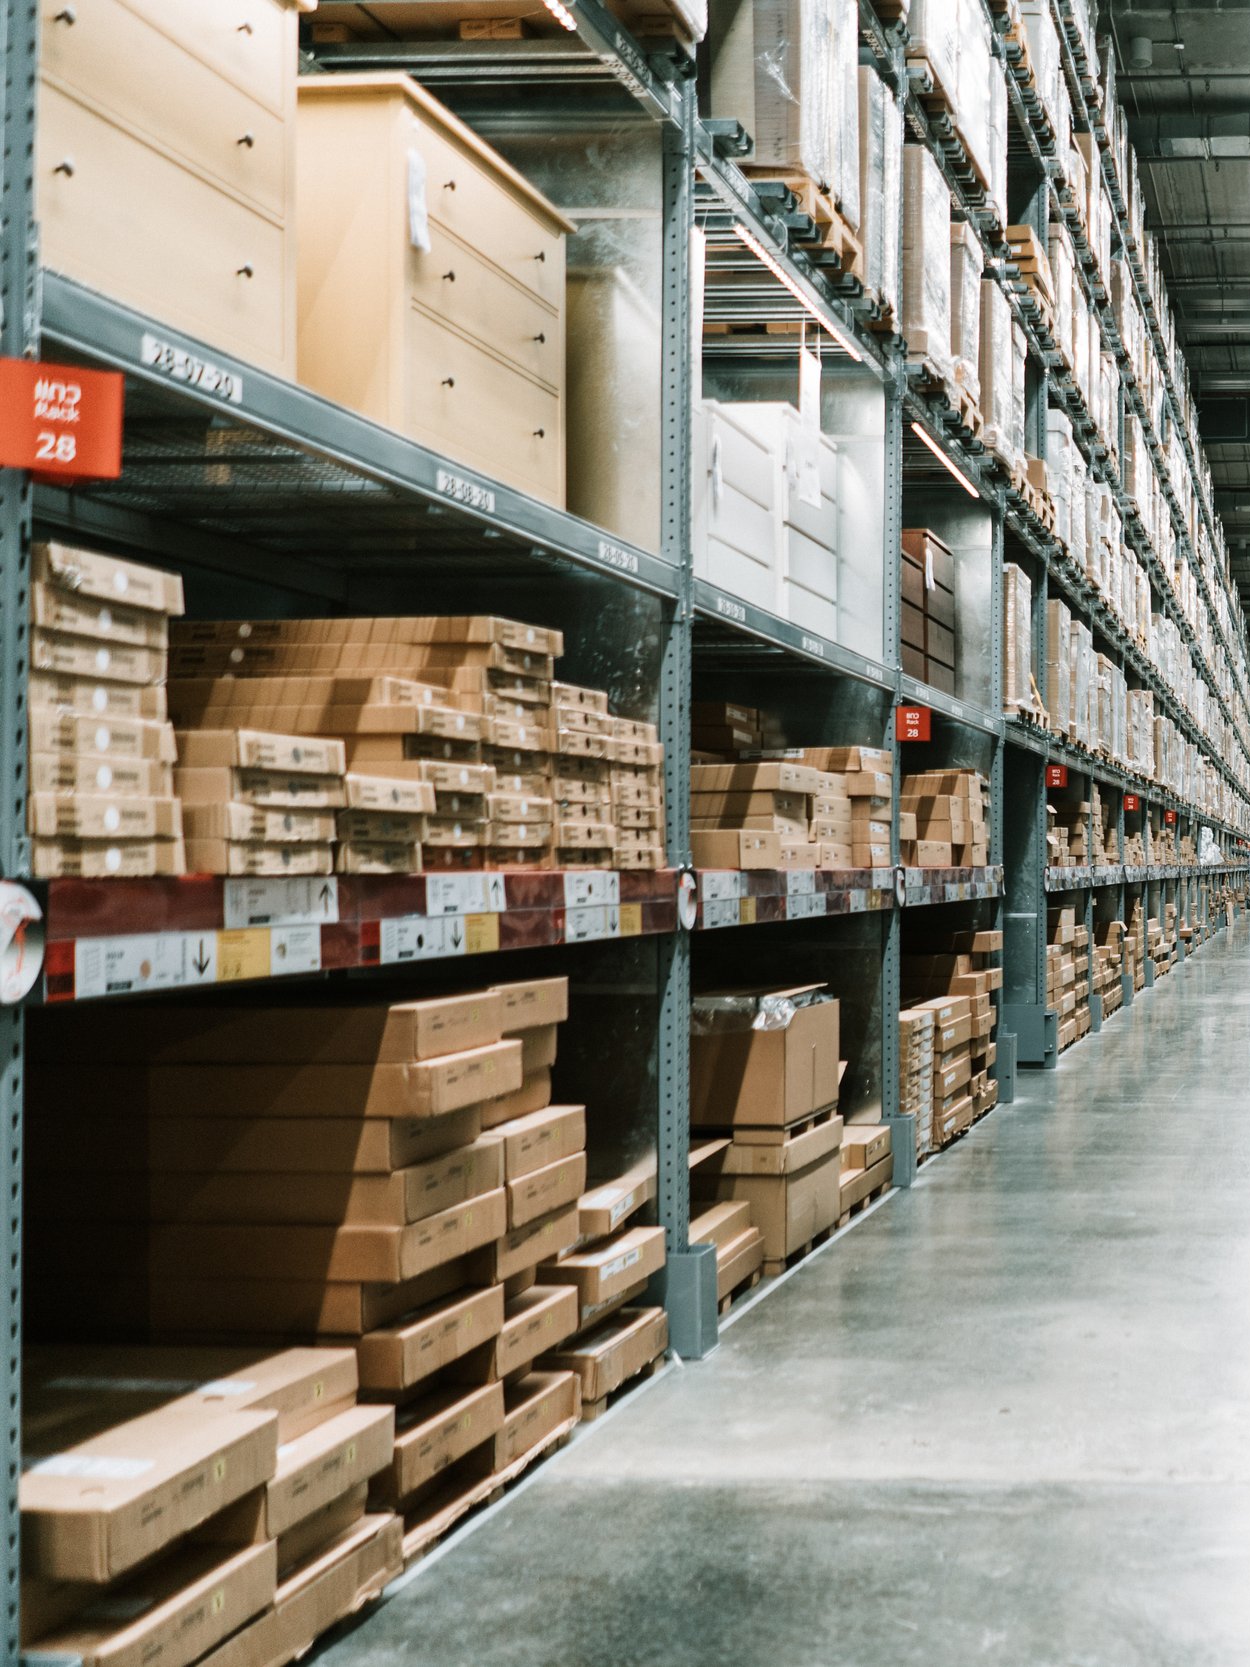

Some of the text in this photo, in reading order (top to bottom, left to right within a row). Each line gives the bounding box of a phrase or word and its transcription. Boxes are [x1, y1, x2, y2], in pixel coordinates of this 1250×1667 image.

[152, 342, 234, 401] 28-07-20
[35, 400, 81, 422] Rack
[36, 431, 77, 463] 28
[443, 474, 491, 511] 28-08-20
[907, 728, 919, 738] 28
